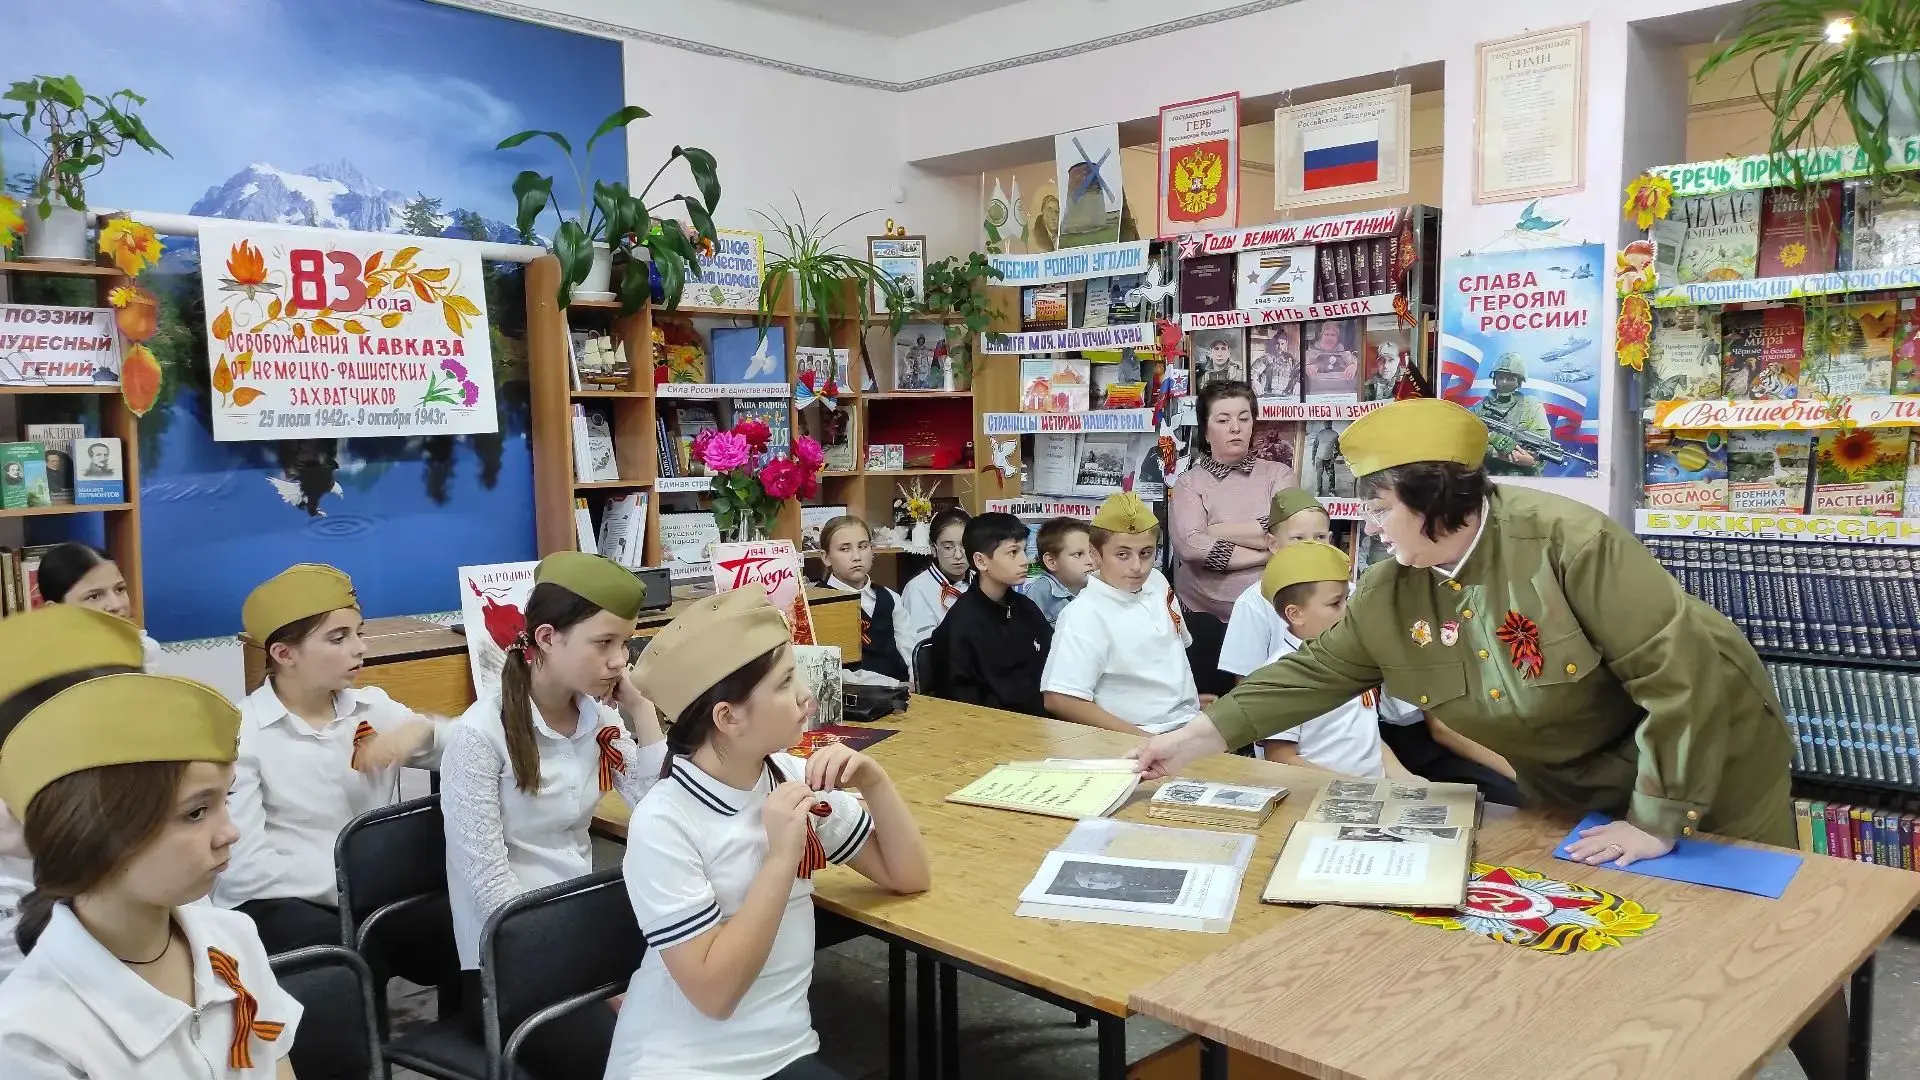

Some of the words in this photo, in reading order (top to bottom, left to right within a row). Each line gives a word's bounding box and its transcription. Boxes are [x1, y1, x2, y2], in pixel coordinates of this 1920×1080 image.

[1508, 53, 1551, 70] ГИМН
[1186, 119, 1212, 132] ГЕРБ
[1657, 167, 1731, 191] ЕРЕЧЬ
[1243, 226, 1298, 248] ВЕЛИКИХ
[1303, 211, 1397, 240] ИСПЫТАНИЙ
[1044, 253, 1088, 277] РОДНОЙ
[1093, 247, 1142, 271] УГОЛОК
[290, 249, 367, 312] 83
[1459, 271, 1538, 292] СЛАВА
[366, 296, 412, 313] года
[1470, 290, 1566, 312] ГЕРОЯМ
[5, 308, 94, 326] ПОЭЗИИ
[1191, 312, 1251, 328] ПОДВИГУ
[1261, 308, 1304, 323] ЖИТЬ
[1310, 306, 1319, 318] В
[1324, 300, 1372, 317] ВЕКАХ
[1481, 310, 1588, 331] РОССИИ!
[1114, 323, 1142, 344] КРАЙ
[227, 332, 349, 356] ОСВОБОЖДЕНИЯ
[358, 335, 465, 357] КАВКАЗА
[22, 360, 95, 377] ГЕНИЙ
[231, 361, 248, 381] ОТ
[250, 360, 428, 383] НЕМЕЦКО-ФАШИСТСКИХ
[290, 386, 396, 406] ЗАХВАТЧИКОВ
[667, 386, 688, 394] Сила
[690, 386, 719, 394] России
[728, 386, 761, 395] единстве
[758, 400, 788, 409] РОДИНА
[1262, 405, 1305, 418] МИРНОГО
[1335, 406, 1342, 418] И
[259, 409, 275, 428] 25
[277, 411, 311, 427] июля
[357, 408, 365, 425] 9
[367, 408, 411, 429] октября
[414, 408, 448, 426] 1943г.
[988, 414, 1038, 433] СТРАНИЦЫ
[1041, 414, 1082, 431] ИСТОРИИ
[1083, 413, 1118, 431] НАШЕГО
[1120, 413, 1145, 430] СЕЛА
[659, 480, 689, 489] Единая
[1652, 488, 1722, 506] КОСМОС
[1735, 489, 1786, 499] ВОЕННАЯ
[1735, 498, 1787, 508] ТЕХНИКА
[1817, 492, 1895, 508] РАСТЕНИЯ
[1011, 501, 1043, 515] ВОЙНЫ
[1045, 504, 1051, 513] И
[1053, 503, 1091, 515] ПАМЯТЬ
[751, 548, 766, 556] 1941
[772, 546, 789, 554] 1945
[481, 573, 493, 583] ЗА
